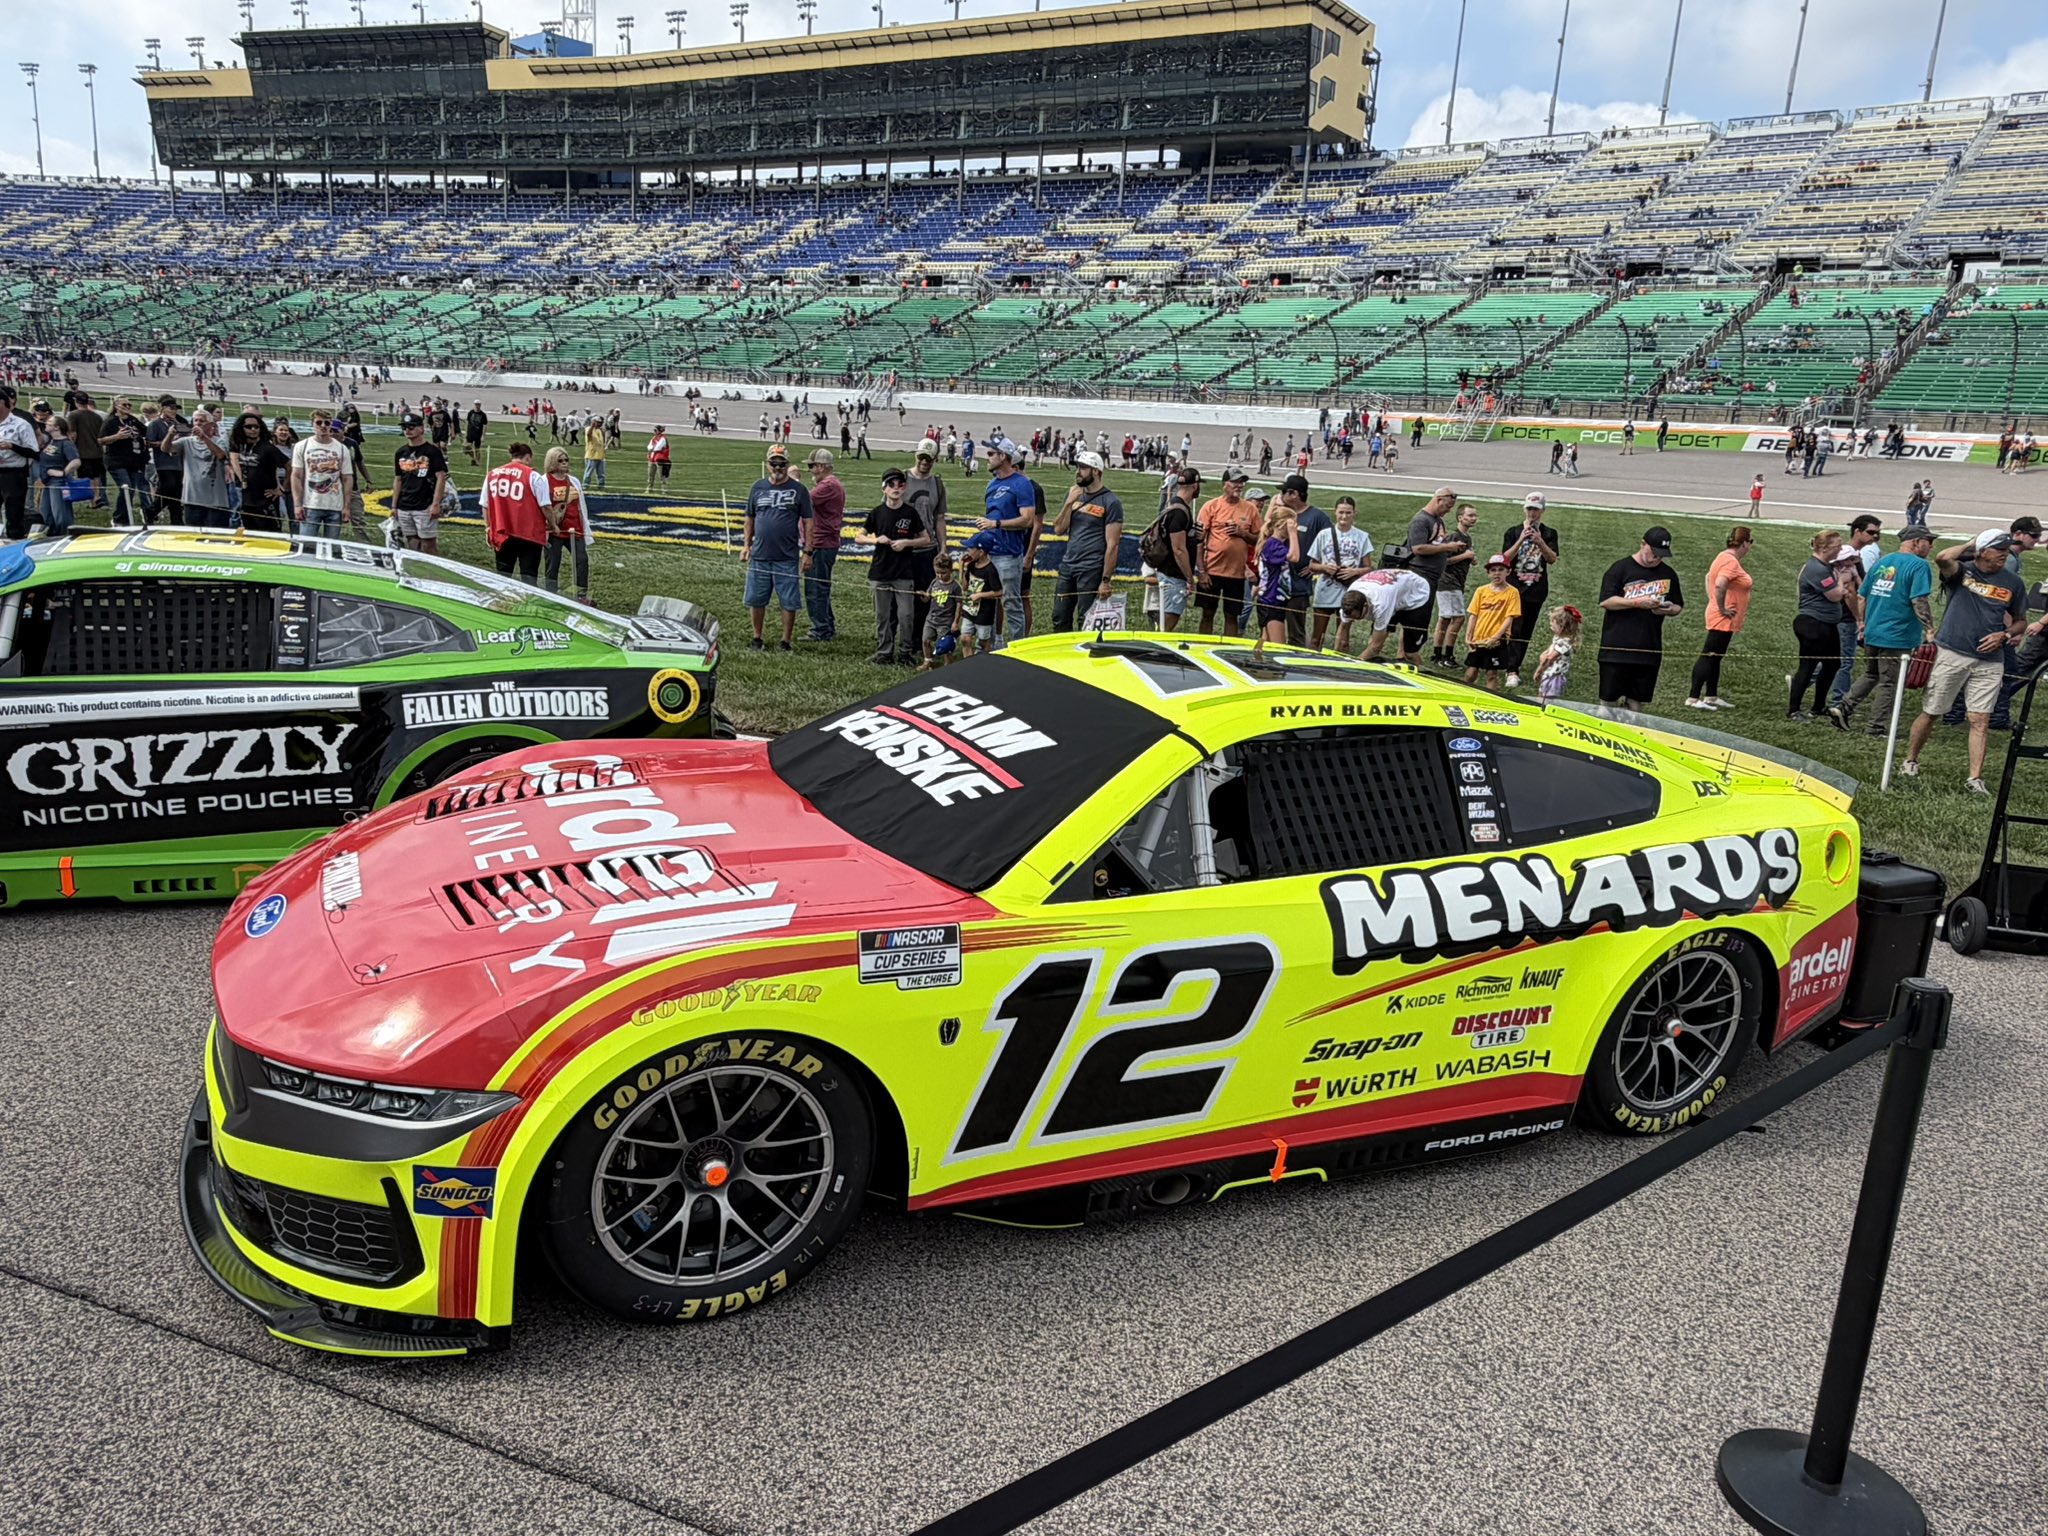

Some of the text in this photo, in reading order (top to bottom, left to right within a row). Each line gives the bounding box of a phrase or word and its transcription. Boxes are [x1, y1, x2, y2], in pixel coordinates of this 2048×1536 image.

[1501, 426, 1557, 441] POET
[1664, 433, 1729, 449] POET
[489, 478, 525, 501] 580
[138, 562, 252, 576] allmendinger
[477, 628, 572, 643] Leaf Filter
[492, 681, 516, 692] THE
[0, 703, 55, 716] WARNING:
[57, 702, 79, 712] This
[81, 699, 119, 714] product
[121, 698, 162, 709] contains
[163, 696, 204, 707] nicotine.
[206, 694, 245, 705] Nicotine
[247, 694, 255, 704] is
[257, 695, 269, 703] an
[270, 692, 311, 702] addictive
[404, 691, 610, 725] FALLEN OUTDOORS
[1270, 704, 1422, 718] RYAN BLANEY
[900, 686, 1058, 758] TEAM
[1453, 738, 1479, 750] Ford
[1578, 730, 1655, 764] ADVANCE
[6, 724, 359, 798] GRIZZLY
[819, 709, 1005, 807] PENSKE
[1461, 763, 1485, 780] PPG
[1459, 786, 1493, 797] Mazak
[1692, 781, 1728, 798] DEX
[23, 787, 354, 827] NICOTINE POUCHES
[1468, 810, 1495, 819] WIZARD
[1326, 828, 1801, 962] MENARDS
[250, 897, 283, 933] Ford
[891, 929, 945, 947] NASCAR
[1667, 932, 1728, 962] EAGLE
[874, 950, 947, 969] CUP SERIES
[906, 973, 954, 987] THE CHASE
[1455, 977, 1513, 999] Richmond
[1519, 966, 1565, 990] KNAUF
[1405, 994, 1446, 1009] KIDDE
[1451, 1005, 1552, 1036] DISCOUNT
[1302, 1032, 1423, 1063] Snap-on
[1477, 1030, 1519, 1045] TIRE
[941, 933, 1282, 1167] 12
[1435, 1050, 1551, 1080] WABASH
[1424, 1119, 1565, 1151] FORD RACING
[417, 1185, 492, 1201] SUNOCO
[676, 1268, 788, 1319] EAGLE
